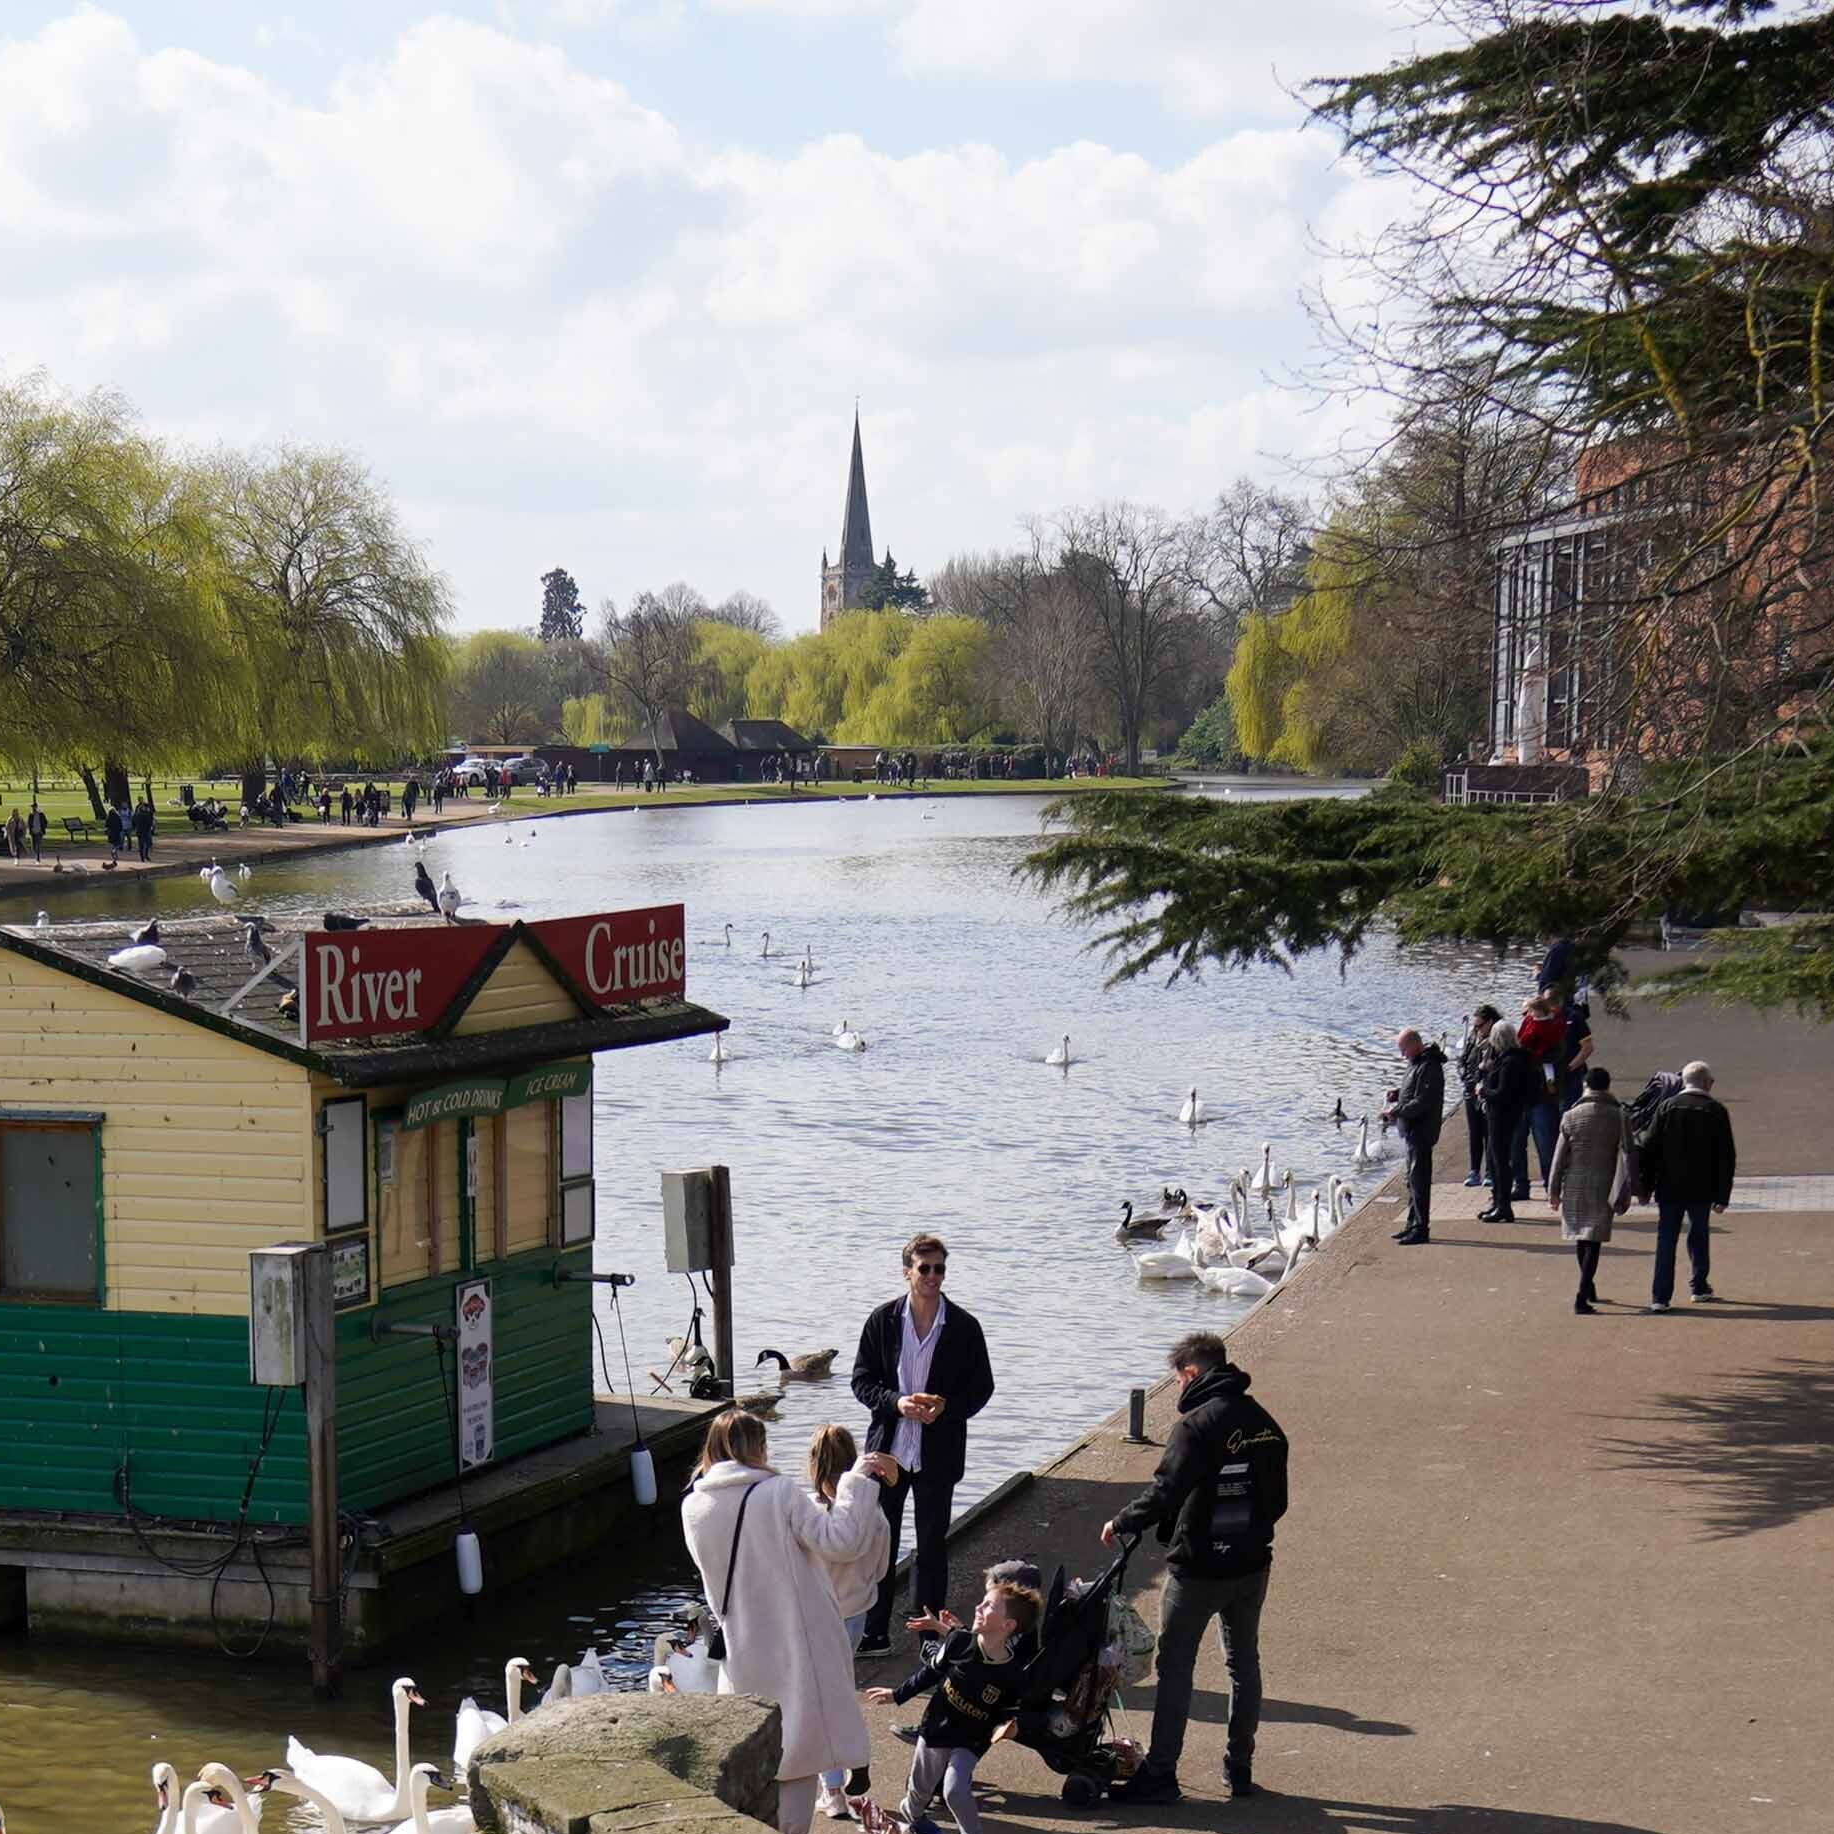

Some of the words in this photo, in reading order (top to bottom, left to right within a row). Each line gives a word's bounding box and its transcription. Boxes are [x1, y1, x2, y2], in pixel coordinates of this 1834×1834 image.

[315, 945, 422, 1027] River
[585, 919, 683, 994] Cruise
[526, 1078, 543, 1097] ICE
[544, 1072, 577, 1094] CREAM
[407, 1102, 430, 1125] HOT
[431, 1099, 443, 1115] &
[443, 1091, 471, 1112] COLD
[471, 1090, 503, 1110] DRINKS
